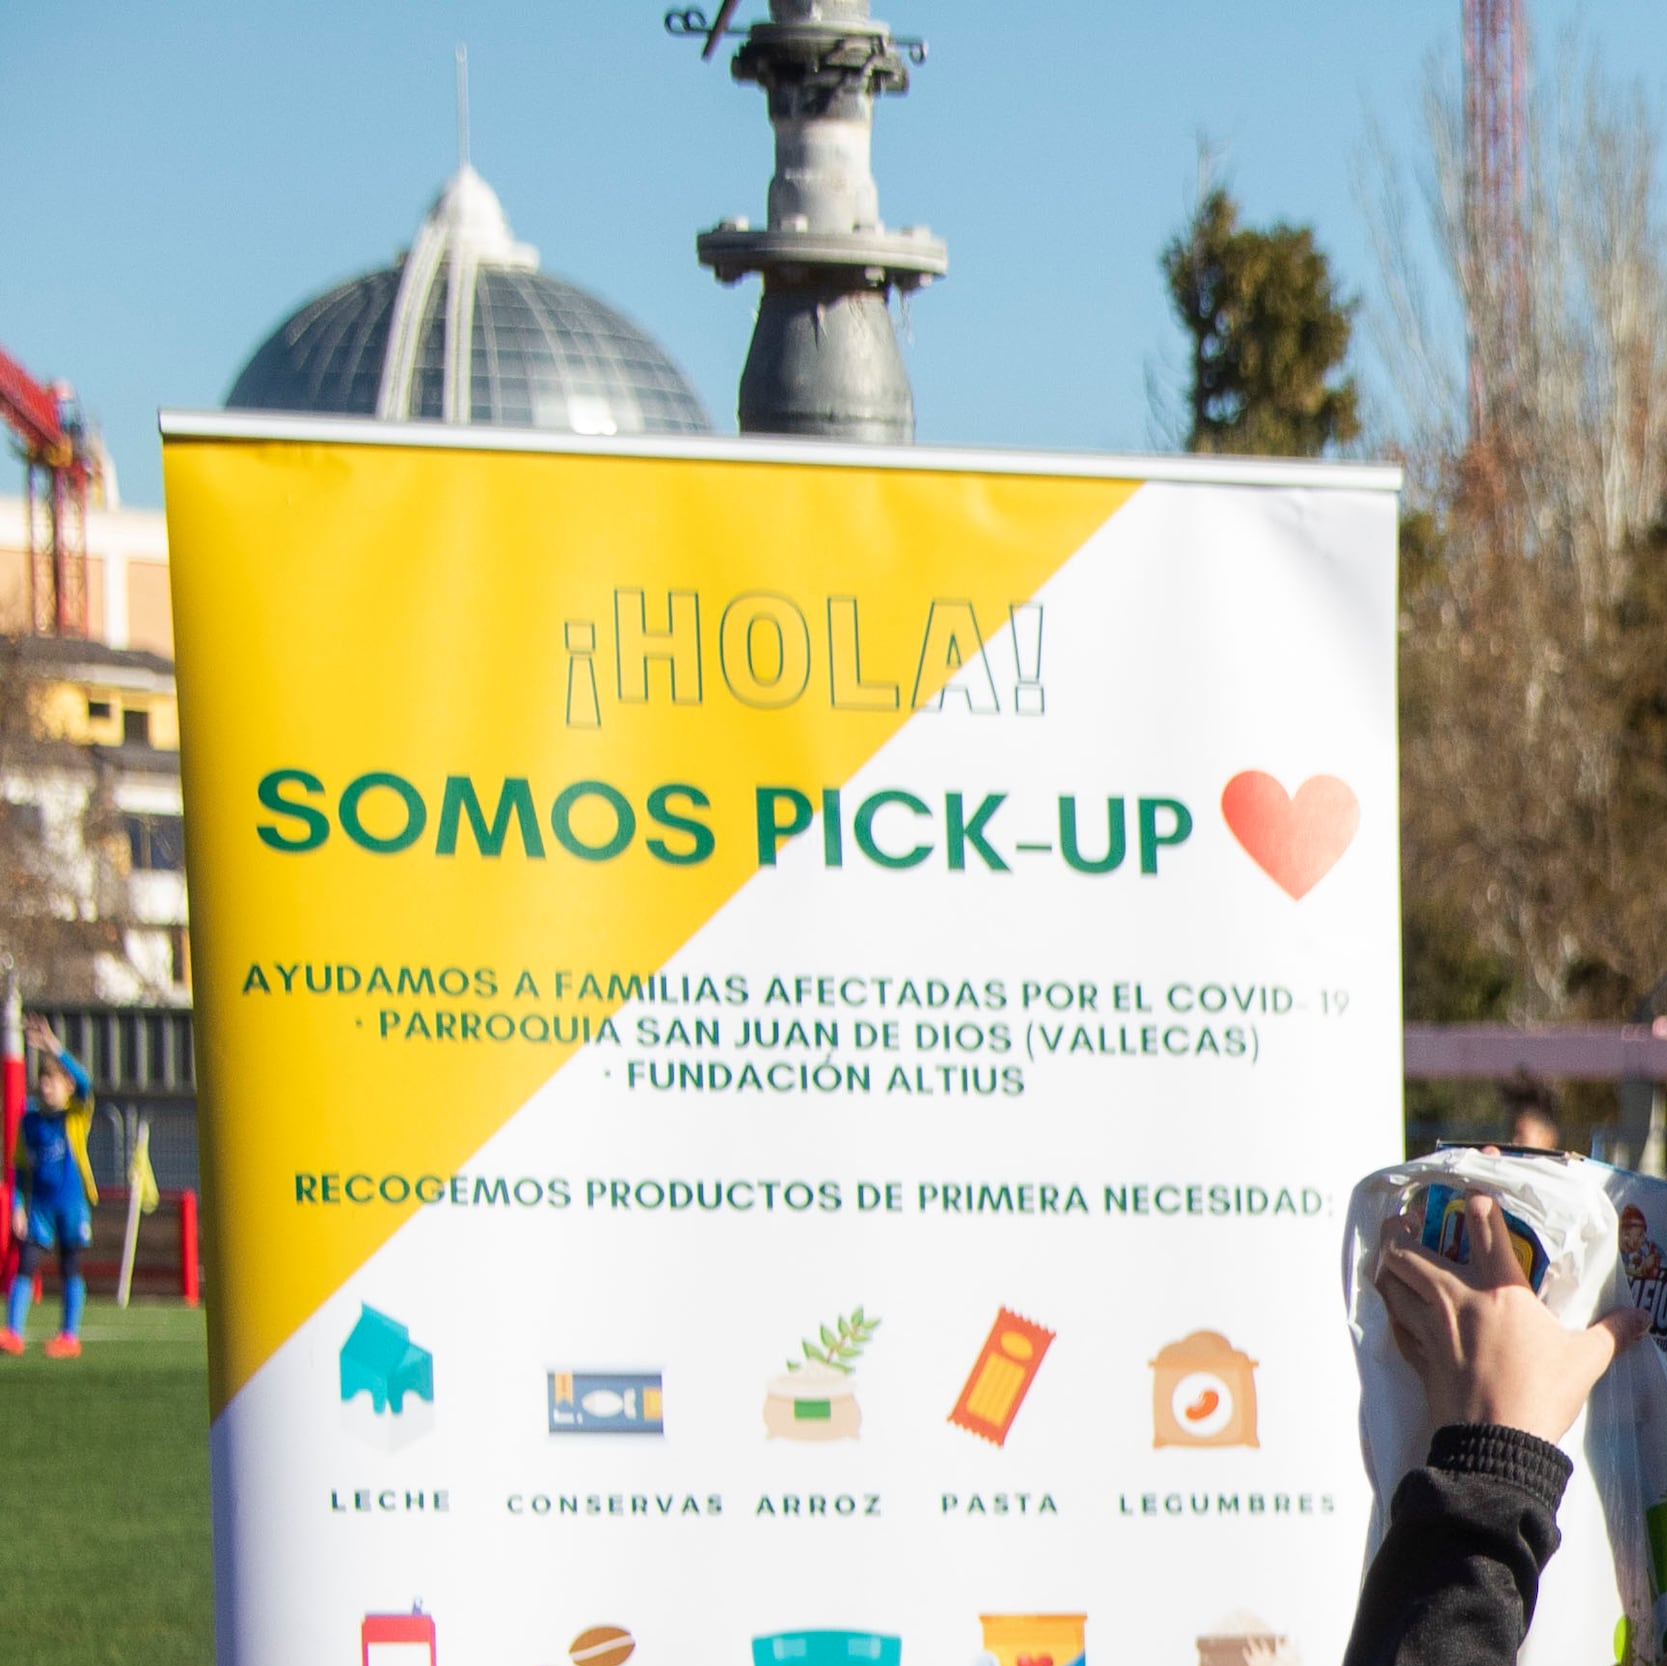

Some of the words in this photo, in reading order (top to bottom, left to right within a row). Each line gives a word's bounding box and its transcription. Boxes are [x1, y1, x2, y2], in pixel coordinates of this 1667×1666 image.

[563, 585, 1048, 730] ¡HOLA!
[255, 767, 716, 867] SOMOS
[754, 785, 1194, 877] PICK-UP
[242, 962, 499, 1000] AYUDAMOS
[513, 969, 541, 1000] A
[556, 970, 750, 1003] FAMILIAS
[763, 975, 1008, 1010] AFECTADAS
[1022, 981, 1099, 1012] POR
[1112, 983, 1153, 1014] EL
[378, 1009, 622, 1047] PARROQUIA
[636, 1017, 722, 1048] SAN
[733, 1018, 840, 1050] JUAN
[854, 1021, 900, 1051] DE
[915, 1022, 1012, 1053] DIOS
[1026, 1023, 1260, 1065] (VALLECAS)
[627, 1052, 871, 1094] FUNDACIÓN
[886, 1064, 1025, 1097] ALTIUS
[294, 1172, 572, 1209] RECOGEMOS
[586, 1178, 844, 1212] PRODUCTOS
[856, 1182, 904, 1212] DE
[918, 1183, 1090, 1215] PRIMERA
[1102, 1184, 1335, 1217] NECESIDAD:
[329, 1487, 453, 1514] LECHE
[505, 1492, 725, 1518] CONSERVAS
[754, 1492, 883, 1518] ARROZ
[940, 1491, 1060, 1517] PASTA
[1117, 1491, 1338, 1517] LEGUMBRES
